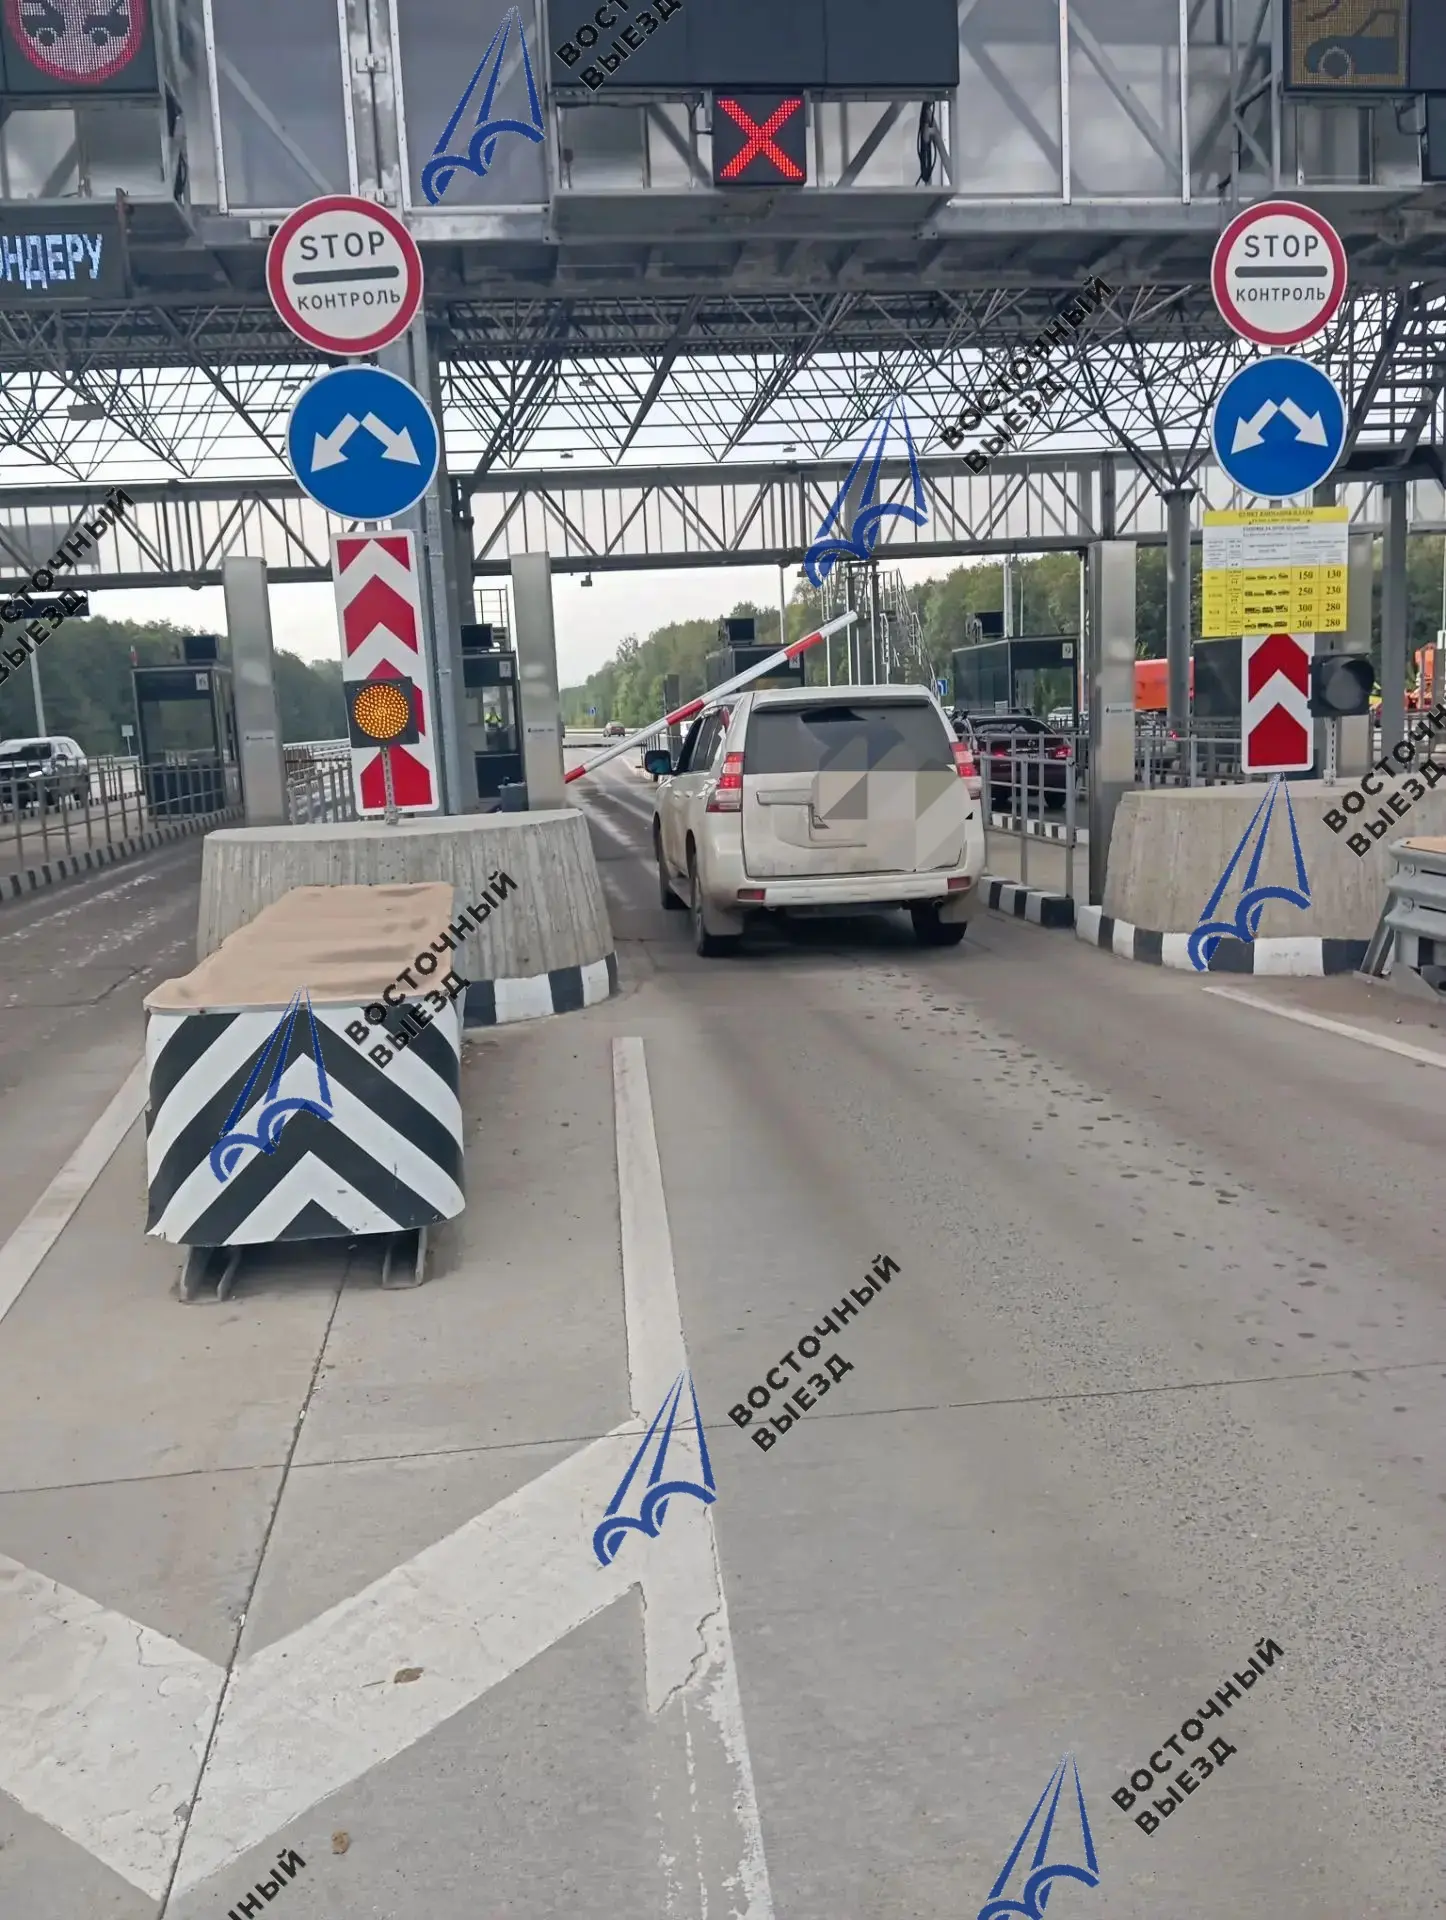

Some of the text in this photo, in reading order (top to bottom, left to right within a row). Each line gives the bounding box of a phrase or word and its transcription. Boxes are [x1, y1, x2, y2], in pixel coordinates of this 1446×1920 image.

[300, 231, 385, 260] STOP
[1244, 235, 1319, 258] STOP
[0, 234, 103, 289] НДЕРУ
[297, 290, 400, 310] КОНТРОЛЬ
[1236, 287, 1325, 303] КОНТРОЛЬ
[1299, 569, 1342, 580] 150 130
[1298, 586, 1341, 597] 250 230
[1297, 603, 1341, 613] 300 280
[1297, 618, 1341, 629] 300 280
